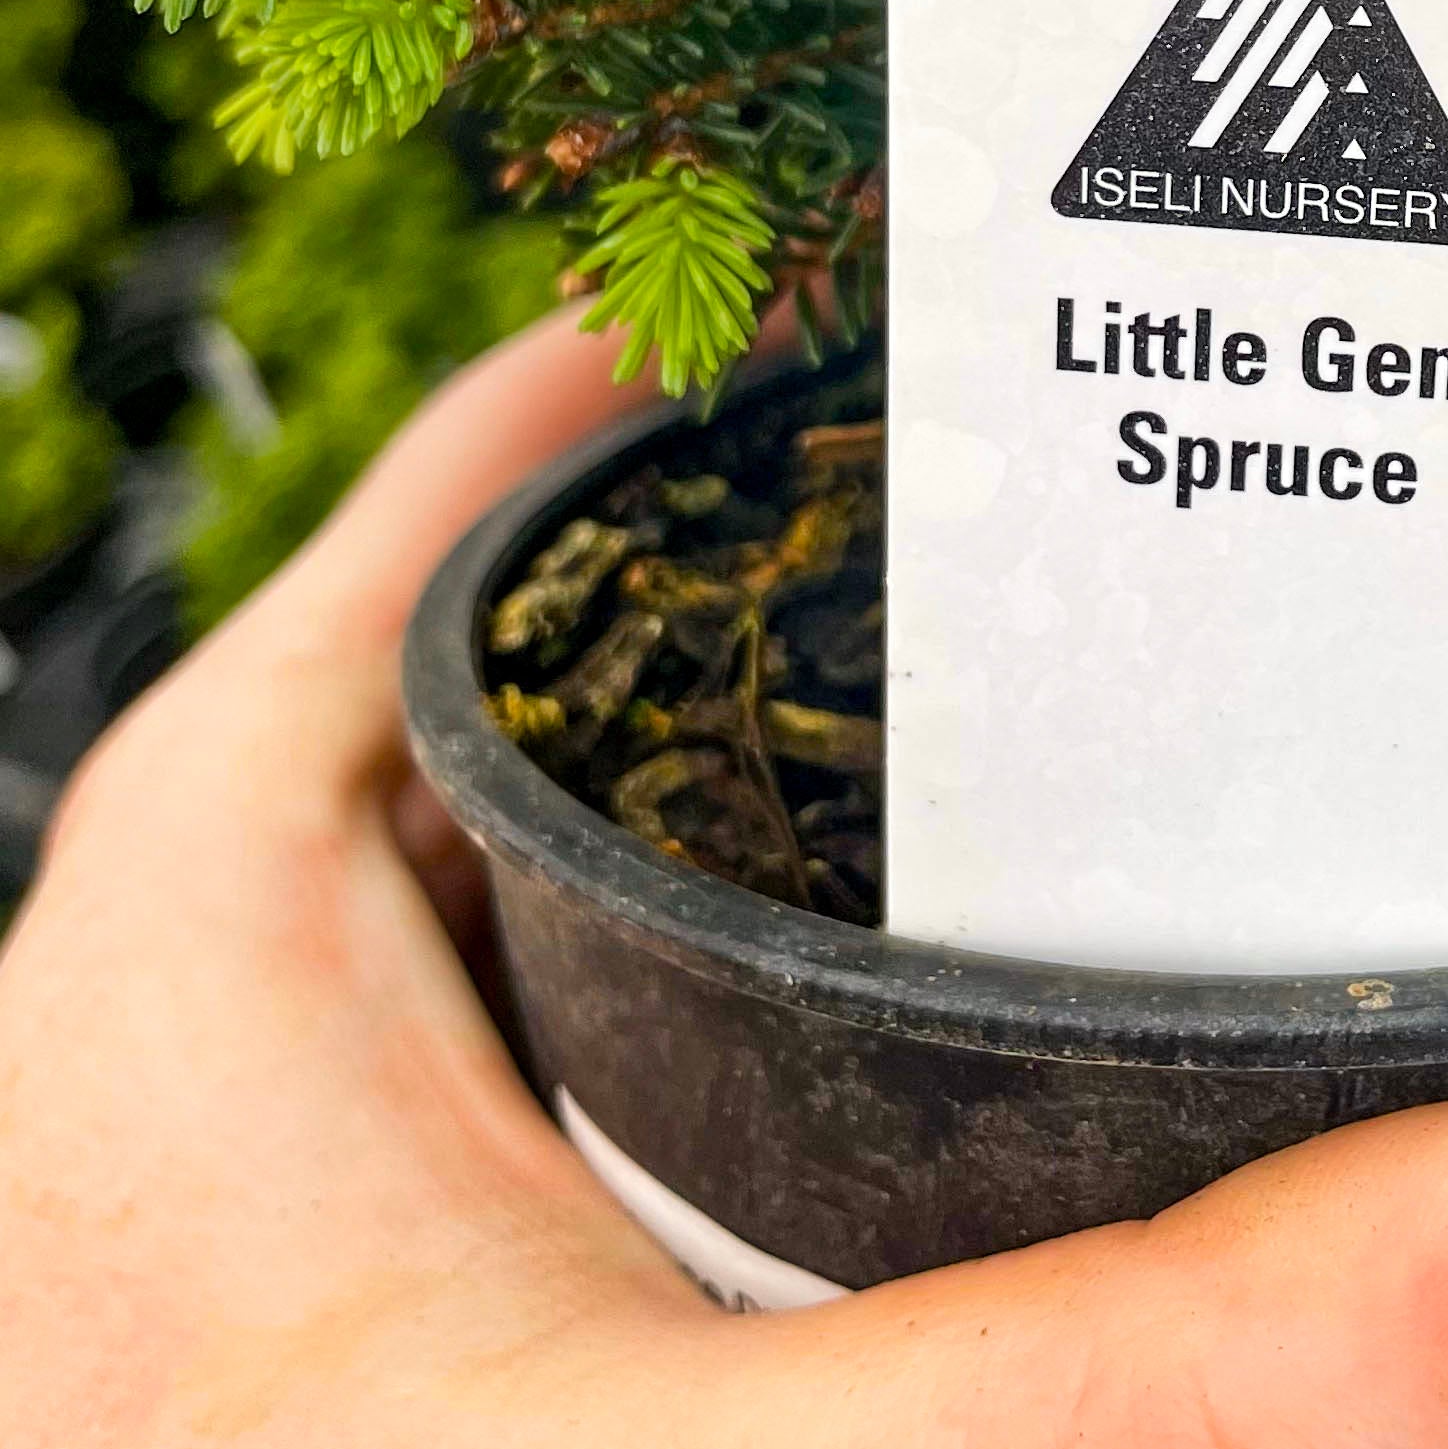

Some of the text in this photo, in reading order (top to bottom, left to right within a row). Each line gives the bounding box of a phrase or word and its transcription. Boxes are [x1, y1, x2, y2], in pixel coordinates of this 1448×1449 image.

[1080, 166, 1202, 215] ISELI
[1055, 297, 1267, 386] Little
[1117, 410, 1418, 509] Spruce
